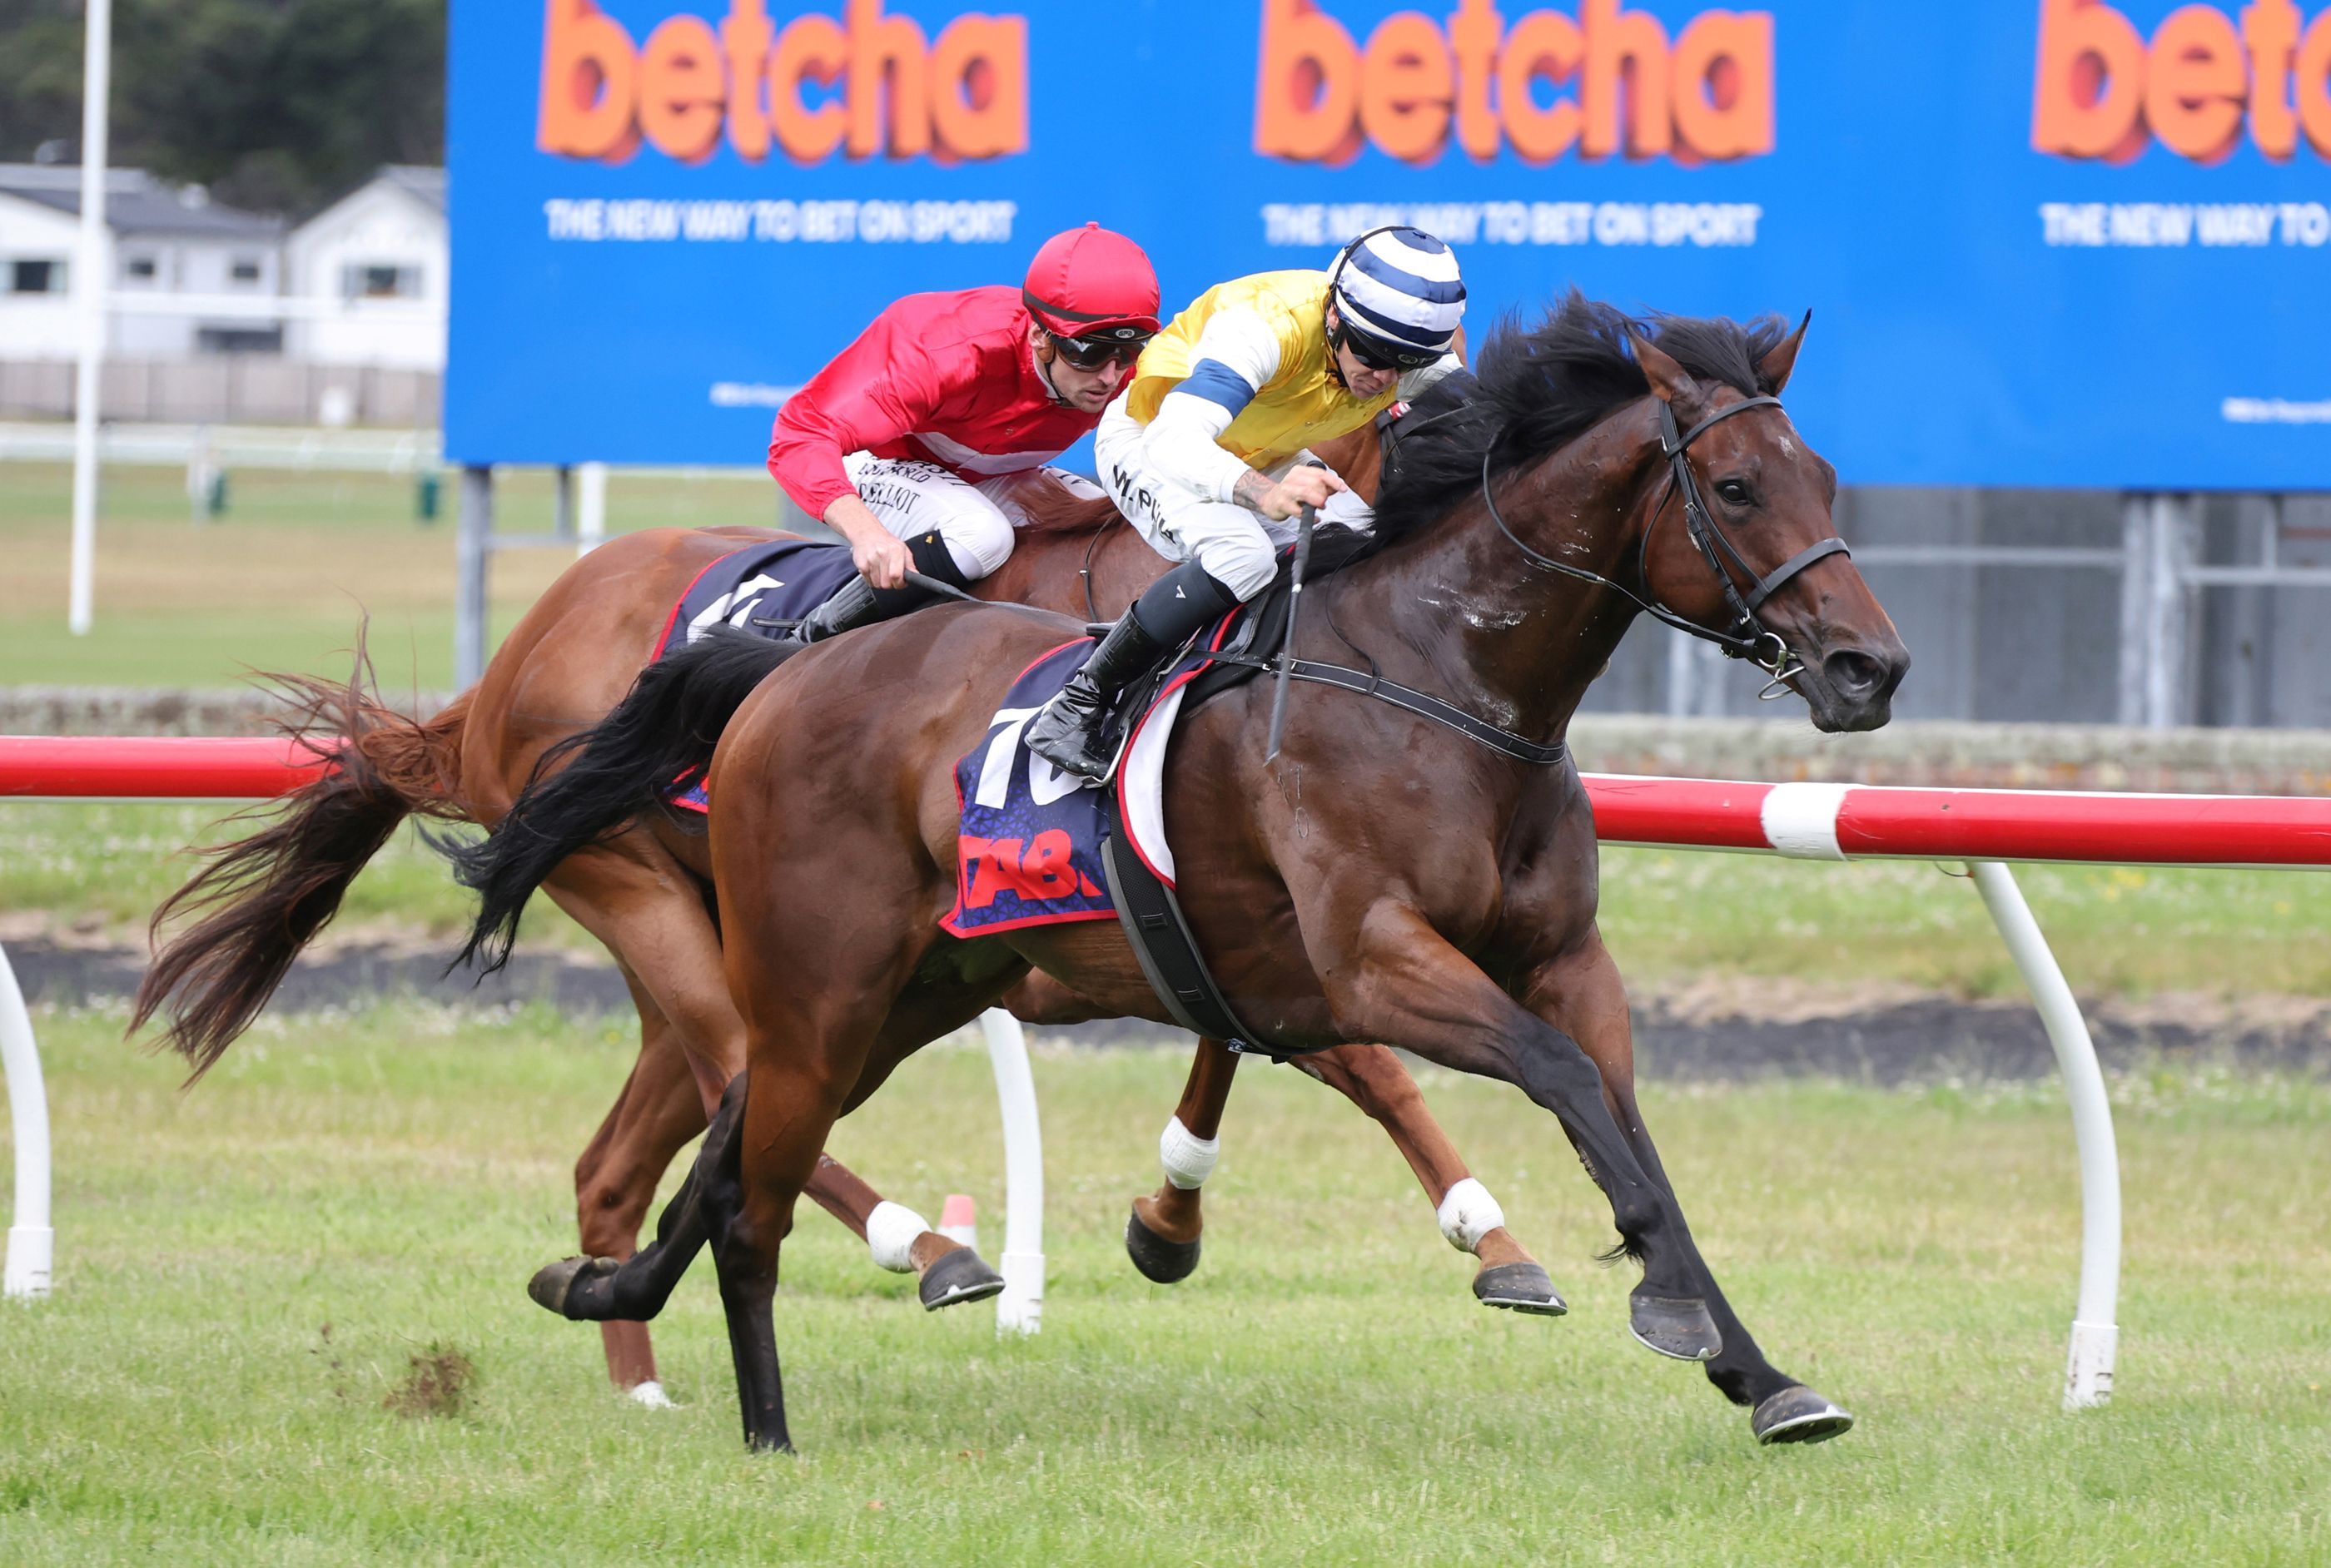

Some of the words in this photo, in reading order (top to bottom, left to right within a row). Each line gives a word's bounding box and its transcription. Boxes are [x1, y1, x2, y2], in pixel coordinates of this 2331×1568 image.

[537, 0, 1029, 166] betcha
[1253, 0, 1775, 167] betcha
[544, 198, 604, 242] THE
[606, 198, 678, 241] NEW
[679, 199, 752, 242] WAY
[752, 199, 798, 243] TO
[799, 200, 858, 243] BET
[858, 199, 909, 243] ON
[910, 200, 1018, 244] SPORT
[1260, 203, 1325, 246] THE
[1481, 201, 1528, 245] TO
[1530, 202, 1592, 246] BET
[1593, 201, 1649, 246] ON
[1650, 202, 1764, 246] SPORT
[2040, 203, 2108, 247] THE
[2110, 203, 2191, 247] NEW
[2193, 203, 2275, 247] WAY
[2276, 202, 2330, 247] TO
